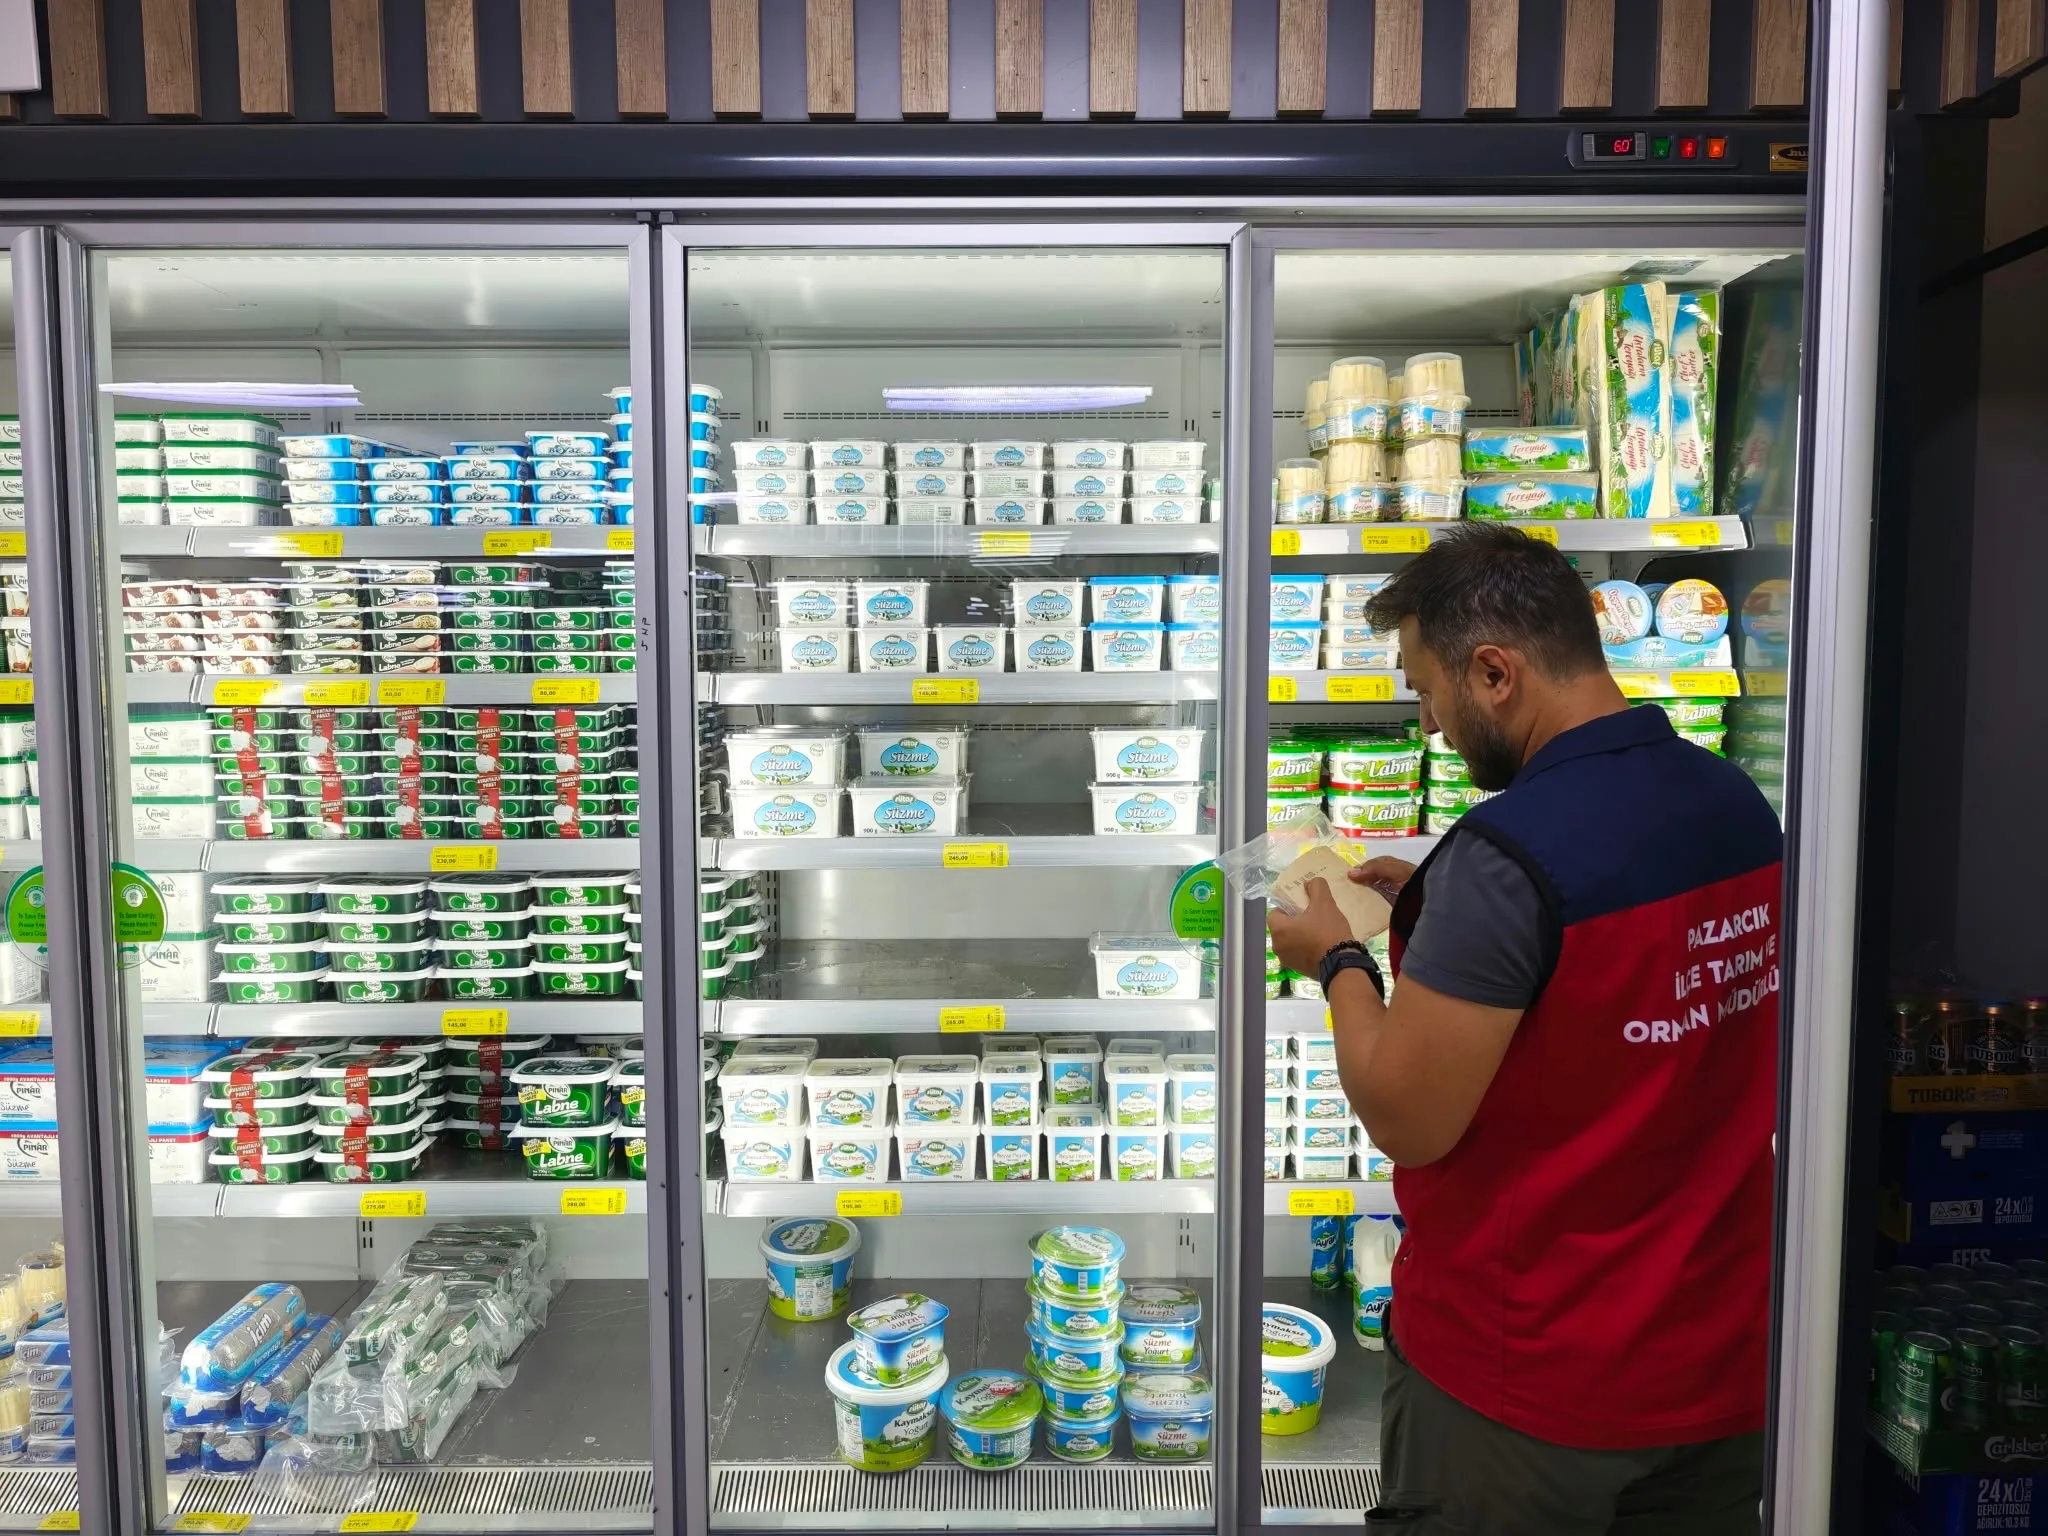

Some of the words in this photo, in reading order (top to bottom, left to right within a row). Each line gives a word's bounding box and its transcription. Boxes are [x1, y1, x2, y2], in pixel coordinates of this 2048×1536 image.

[1623, 342, 1636, 380] Tereyağı
[1632, 334, 1647, 377] Ustaların
[1511, 443, 1548, 456] Tereyağı
[1505, 490, 1547, 503] Tereyağı
[873, 599, 907, 611] Süzme
[1033, 600, 1066, 612] Süzme
[1112, 597, 1145, 610] Süzme
[799, 645, 830, 657] Süzme
[877, 645, 910, 657] Süzme
[955, 645, 988, 657] Süzme
[1035, 645, 1068, 657] Süzme
[1114, 641, 1147, 654] Süzme
[1680, 704, 1721, 722] Labne
[889, 751, 931, 764] Süzme
[1126, 751, 1169, 765] Süzme
[759, 758, 802, 772] Süzme
[1368, 757, 1418, 779] Labne
[763, 809, 806, 822] Süzme
[883, 807, 927, 820] Süzme
[1125, 806, 1167, 819] Süzme
[1367, 802, 1415, 824] Labne
[564, 894, 589, 905] Labne
[563, 923, 589, 934] Labne
[1688, 903, 1770, 952] PAZARCIK
[563, 951, 589, 962] Labne
[1126, 968, 1169, 983] Süzme
[1675, 965, 1702, 1000] İLÇE
[1707, 946, 1763, 984] TARIM
[564, 980, 589, 991] Labne
[1623, 1004, 1710, 1043] ORMAN
[16, 1084, 42, 1096] PINAR
[1908, 1086, 1976, 1104] TUBORG
[534, 1098, 580, 1117] Labne
[23, 1141, 49, 1153] PINAR
[7, 1157, 37, 1169] Süzme
[539, 1151, 585, 1169] Labne
[1315, 1235, 1338, 1248] Ayran
[1142, 1337, 1172, 1347] Süzme
[1155, 1431, 1188, 1442] Süzme
[1157, 1440, 1185, 1452] Yoğurt
